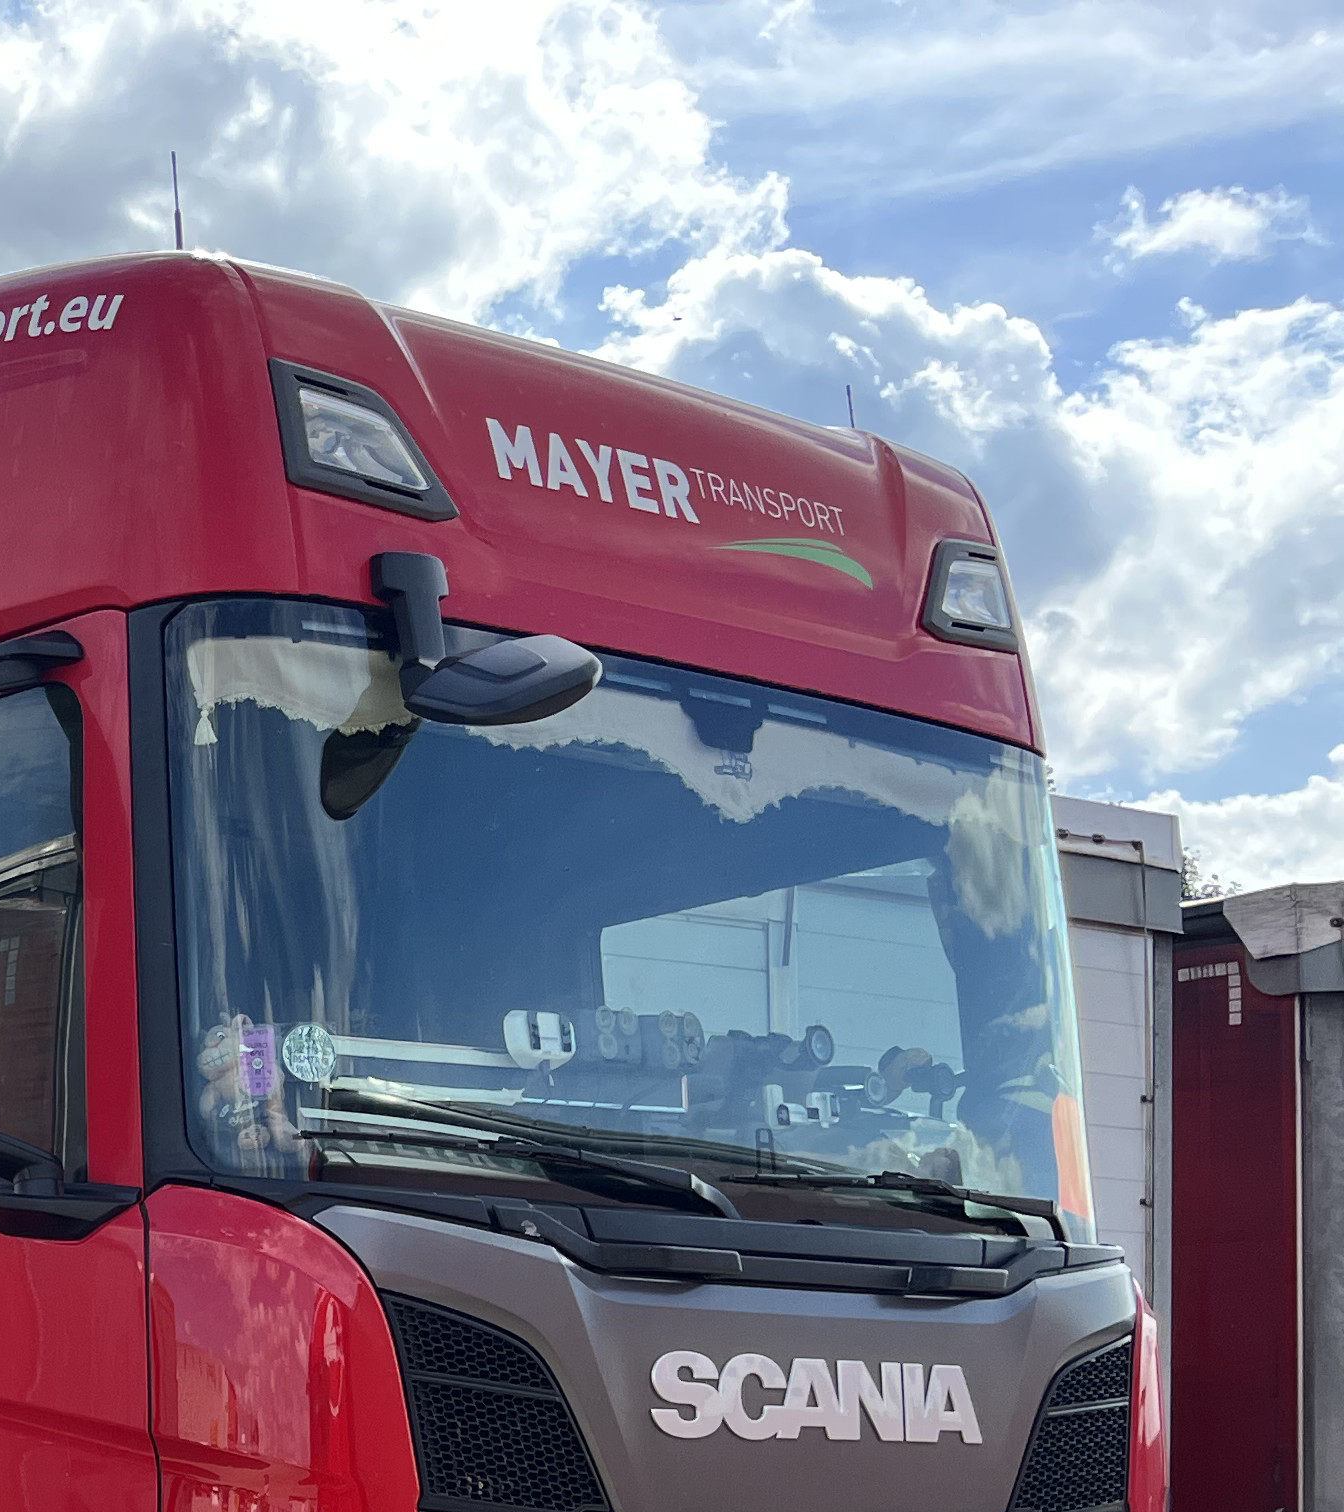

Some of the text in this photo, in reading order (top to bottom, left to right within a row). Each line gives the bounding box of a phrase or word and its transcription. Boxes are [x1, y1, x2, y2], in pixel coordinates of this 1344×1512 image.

[486, 417, 843, 536] MAYER TRANSPORT
[650, 1350, 983, 1445] SCANIA
